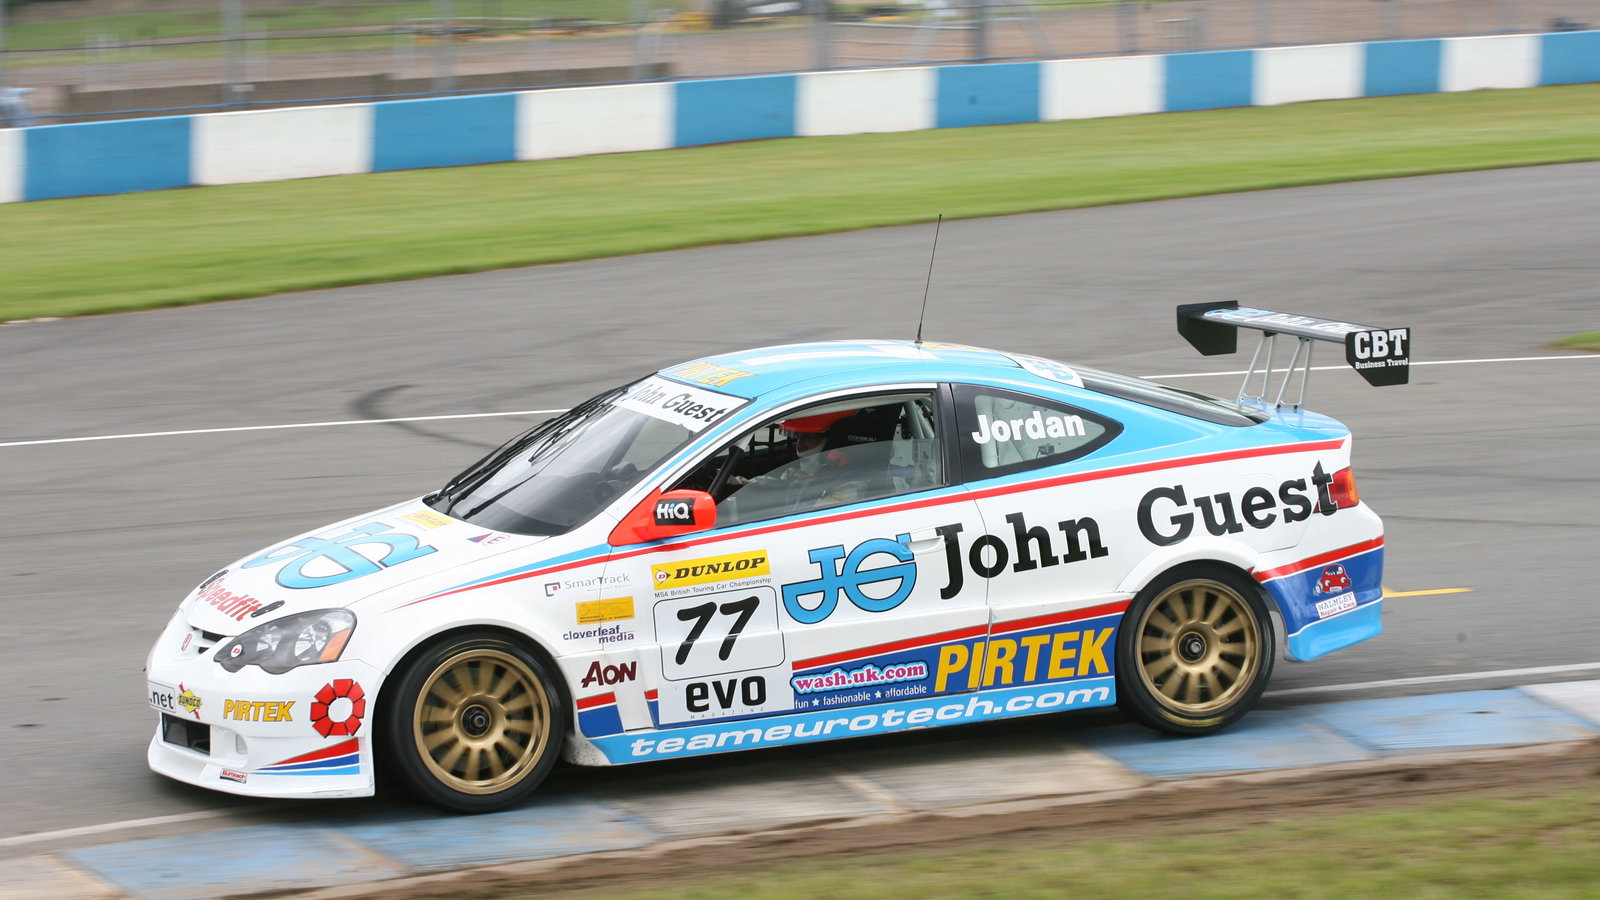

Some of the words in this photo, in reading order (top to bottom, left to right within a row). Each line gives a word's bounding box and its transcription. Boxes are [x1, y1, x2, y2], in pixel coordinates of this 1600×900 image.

[1354, 328, 1408, 359] CBT
[1355, 361, 1386, 370] Business
[1386, 358, 1409, 367] Travel
[620, 384, 667, 405] John
[661, 393, 729, 423] Guest
[971, 411, 1086, 445] Jordan
[656, 502, 690, 521] HiQ
[934, 511, 1109, 600] John
[1136, 460, 1337, 547] Guest
[673, 556, 766, 580] DUNLOP
[564, 572, 631, 590] SmarTrack
[654, 590, 669, 599] MSA
[670, 588, 691, 597] British
[692, 585, 715, 595] Touring
[717, 583, 728, 591] Car
[729, 577, 772, 589] Championship
[1317, 592, 1353, 611] WALMLEY
[562, 624, 621, 641] cloverleaf
[598, 631, 635, 644] media
[675, 596, 760, 666] 77
[933, 627, 1115, 693] PIRTEK
[794, 663, 926, 691] wash.uk.com
[178, 694, 201, 708] SUNOCO
[685, 675, 767, 713] evo
[794, 699, 809, 710] fun
[823, 691, 871, 706] fashionable
[885, 684, 927, 698] affordable
[223, 699, 296, 722] PIRTEK
[630, 686, 1110, 757] teameurotech.com
